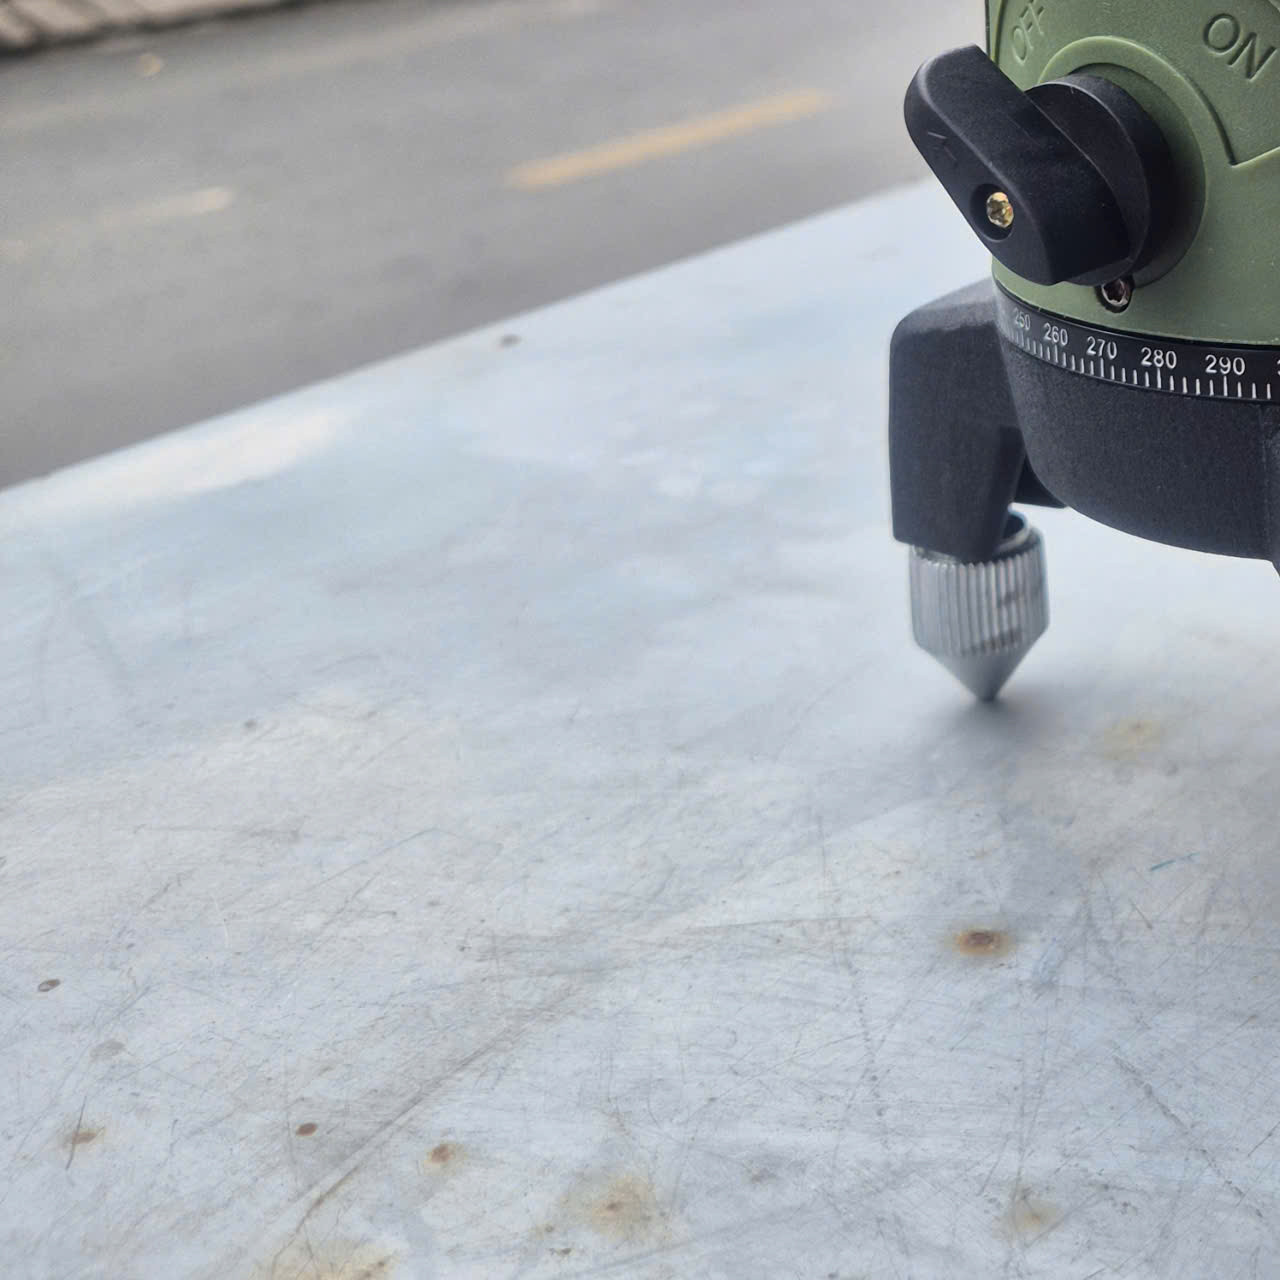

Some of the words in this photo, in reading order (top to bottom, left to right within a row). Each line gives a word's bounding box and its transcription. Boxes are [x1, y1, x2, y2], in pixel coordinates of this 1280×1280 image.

[1203, 12, 1278, 82] ON
[1043, 323, 1068, 345] 260
[1086, 336, 1118, 359] 270
[1141, 347, 1177, 369] 280
[1205, 354, 1246, 376] 290
